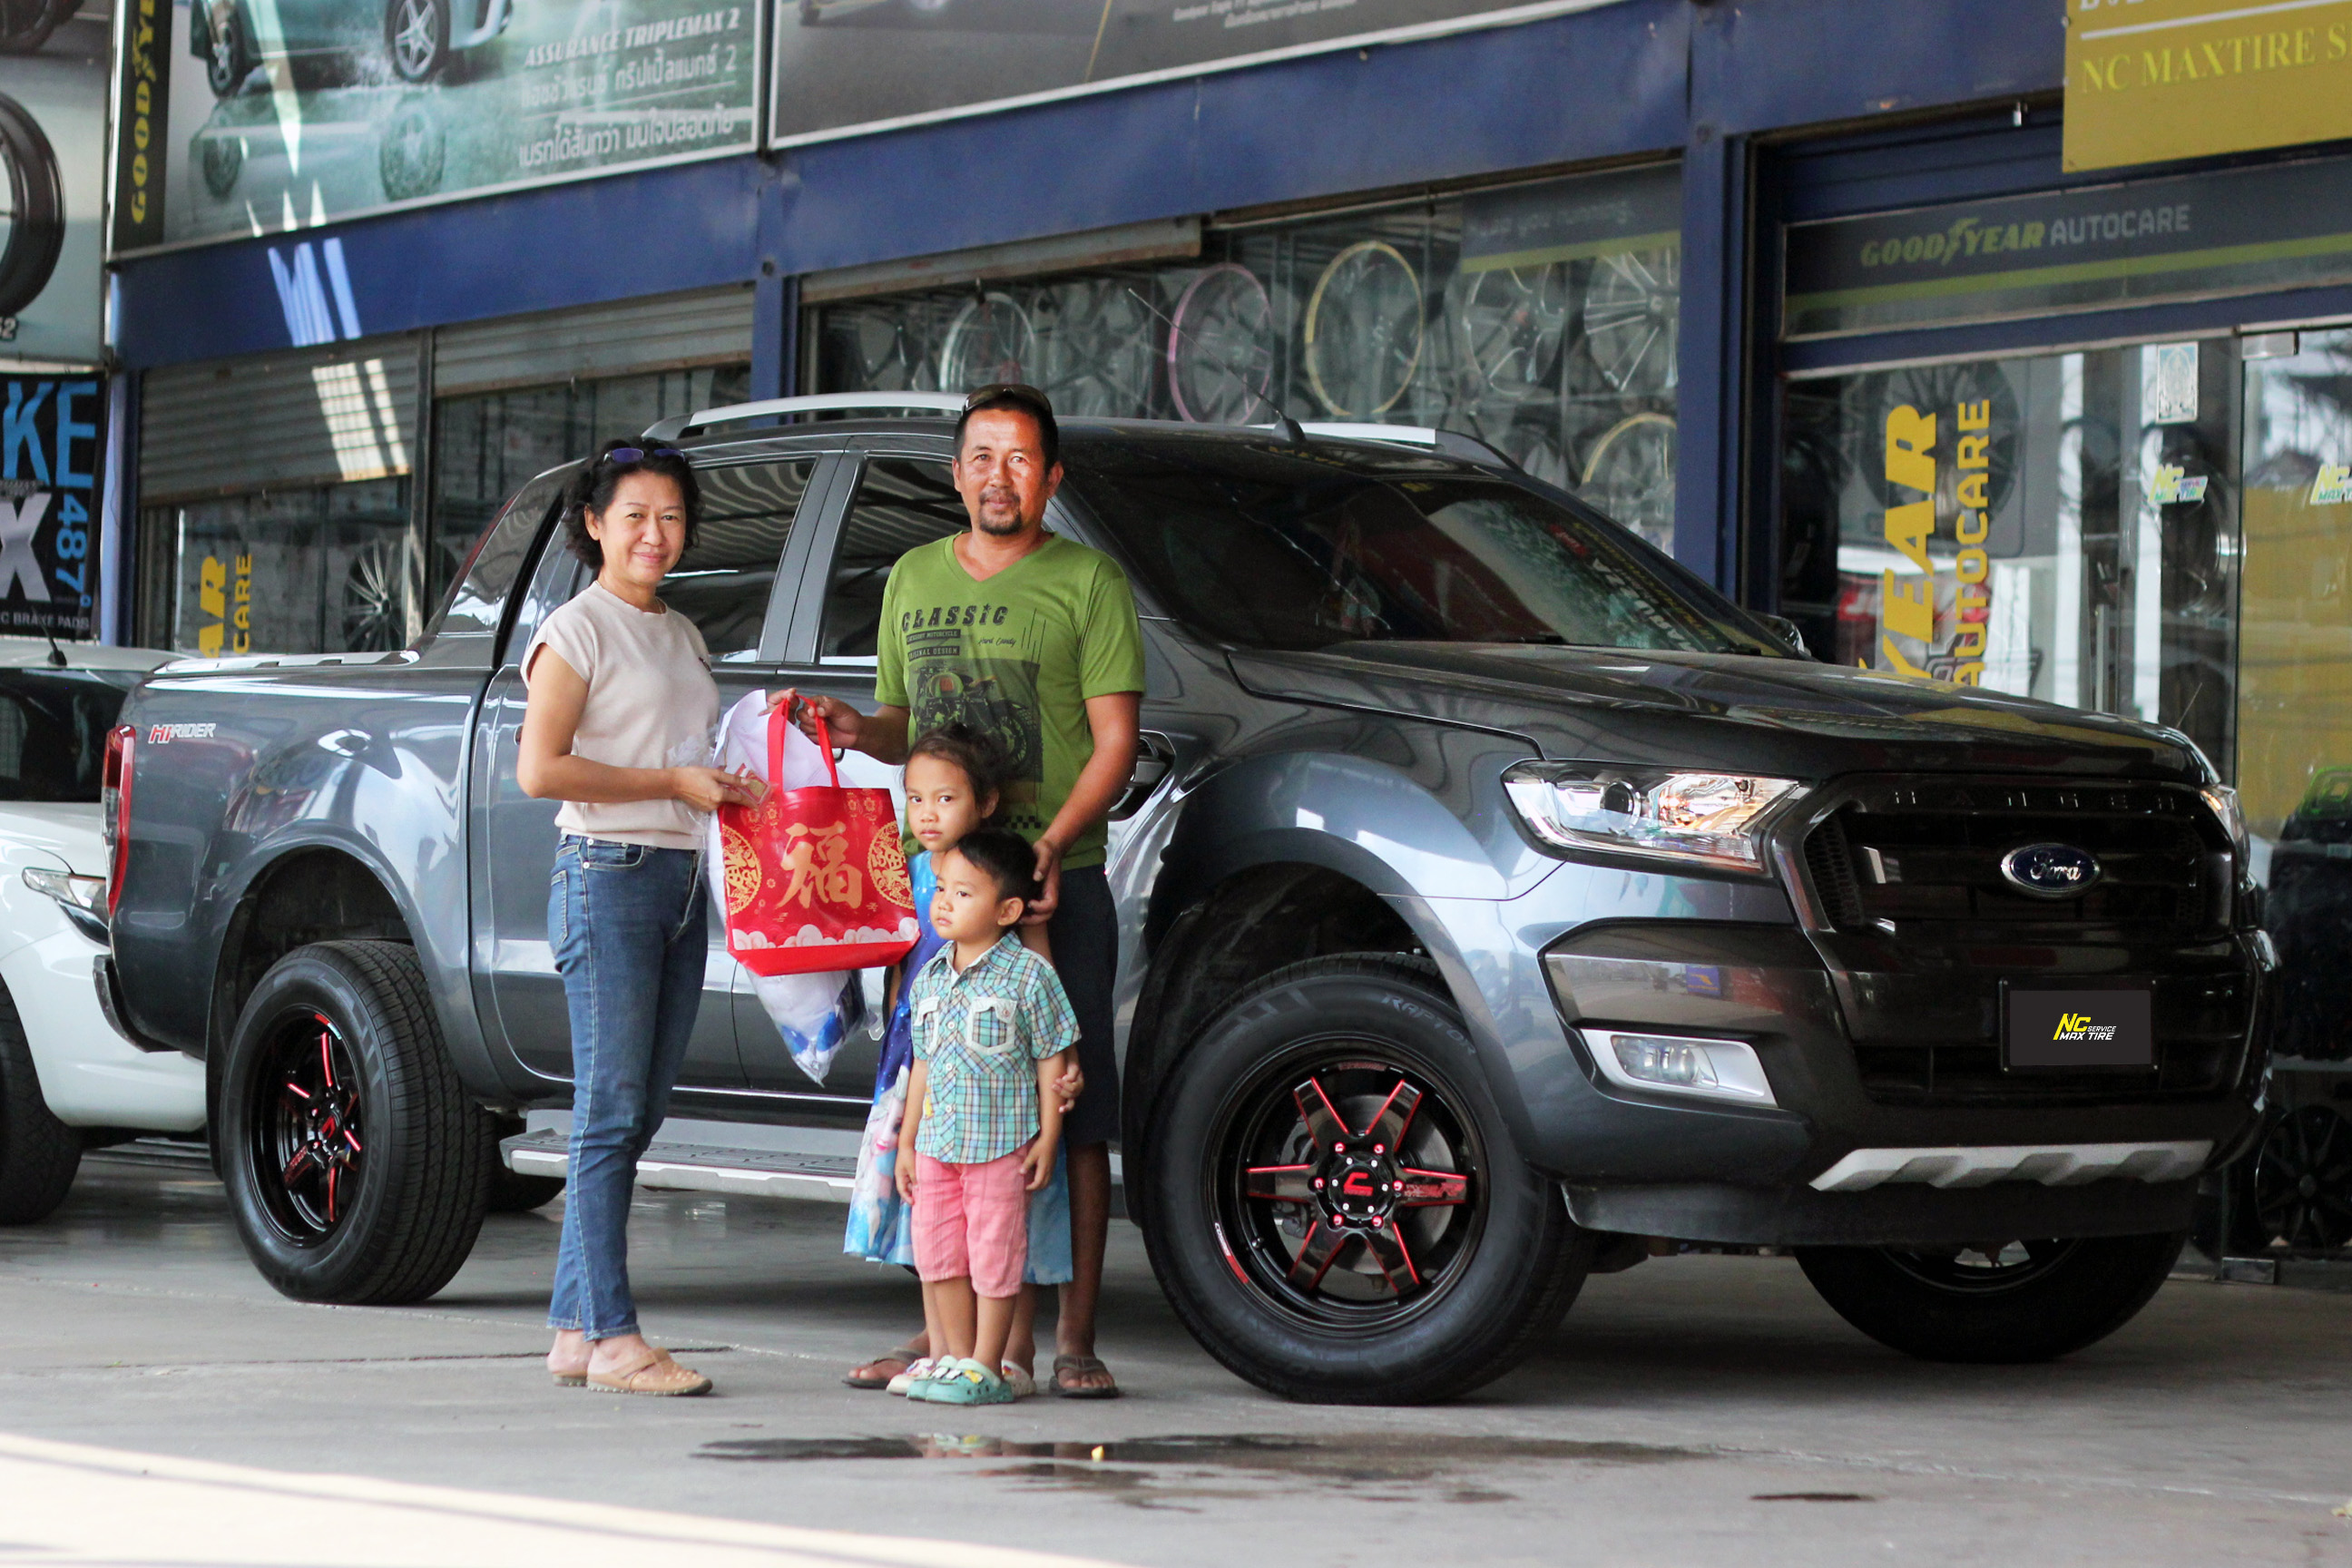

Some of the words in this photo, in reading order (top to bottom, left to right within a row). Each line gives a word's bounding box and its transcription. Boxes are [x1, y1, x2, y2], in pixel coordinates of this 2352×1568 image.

[524, 30, 621, 67] ASSURANCE
[624, 11, 725, 47] TRIPLEMAX
[727, 7, 740, 29] 2
[725, 44, 737, 72] 2
[2082, 53, 2131, 93] NC
[2141, 27, 2315, 87] MAXTIRE
[1860, 218, 2045, 267] GOODYEAR
[2050, 204, 2190, 246] AUTOCARE
[2311, 465, 2350, 503] NC
[1954, 399, 1990, 686] AUTOCARE
[57, 615, 90, 631] PADS
[233, 554, 251, 654] CARE
[776, 820, 862, 909] 福
[2029, 850, 2082, 881] Ford
